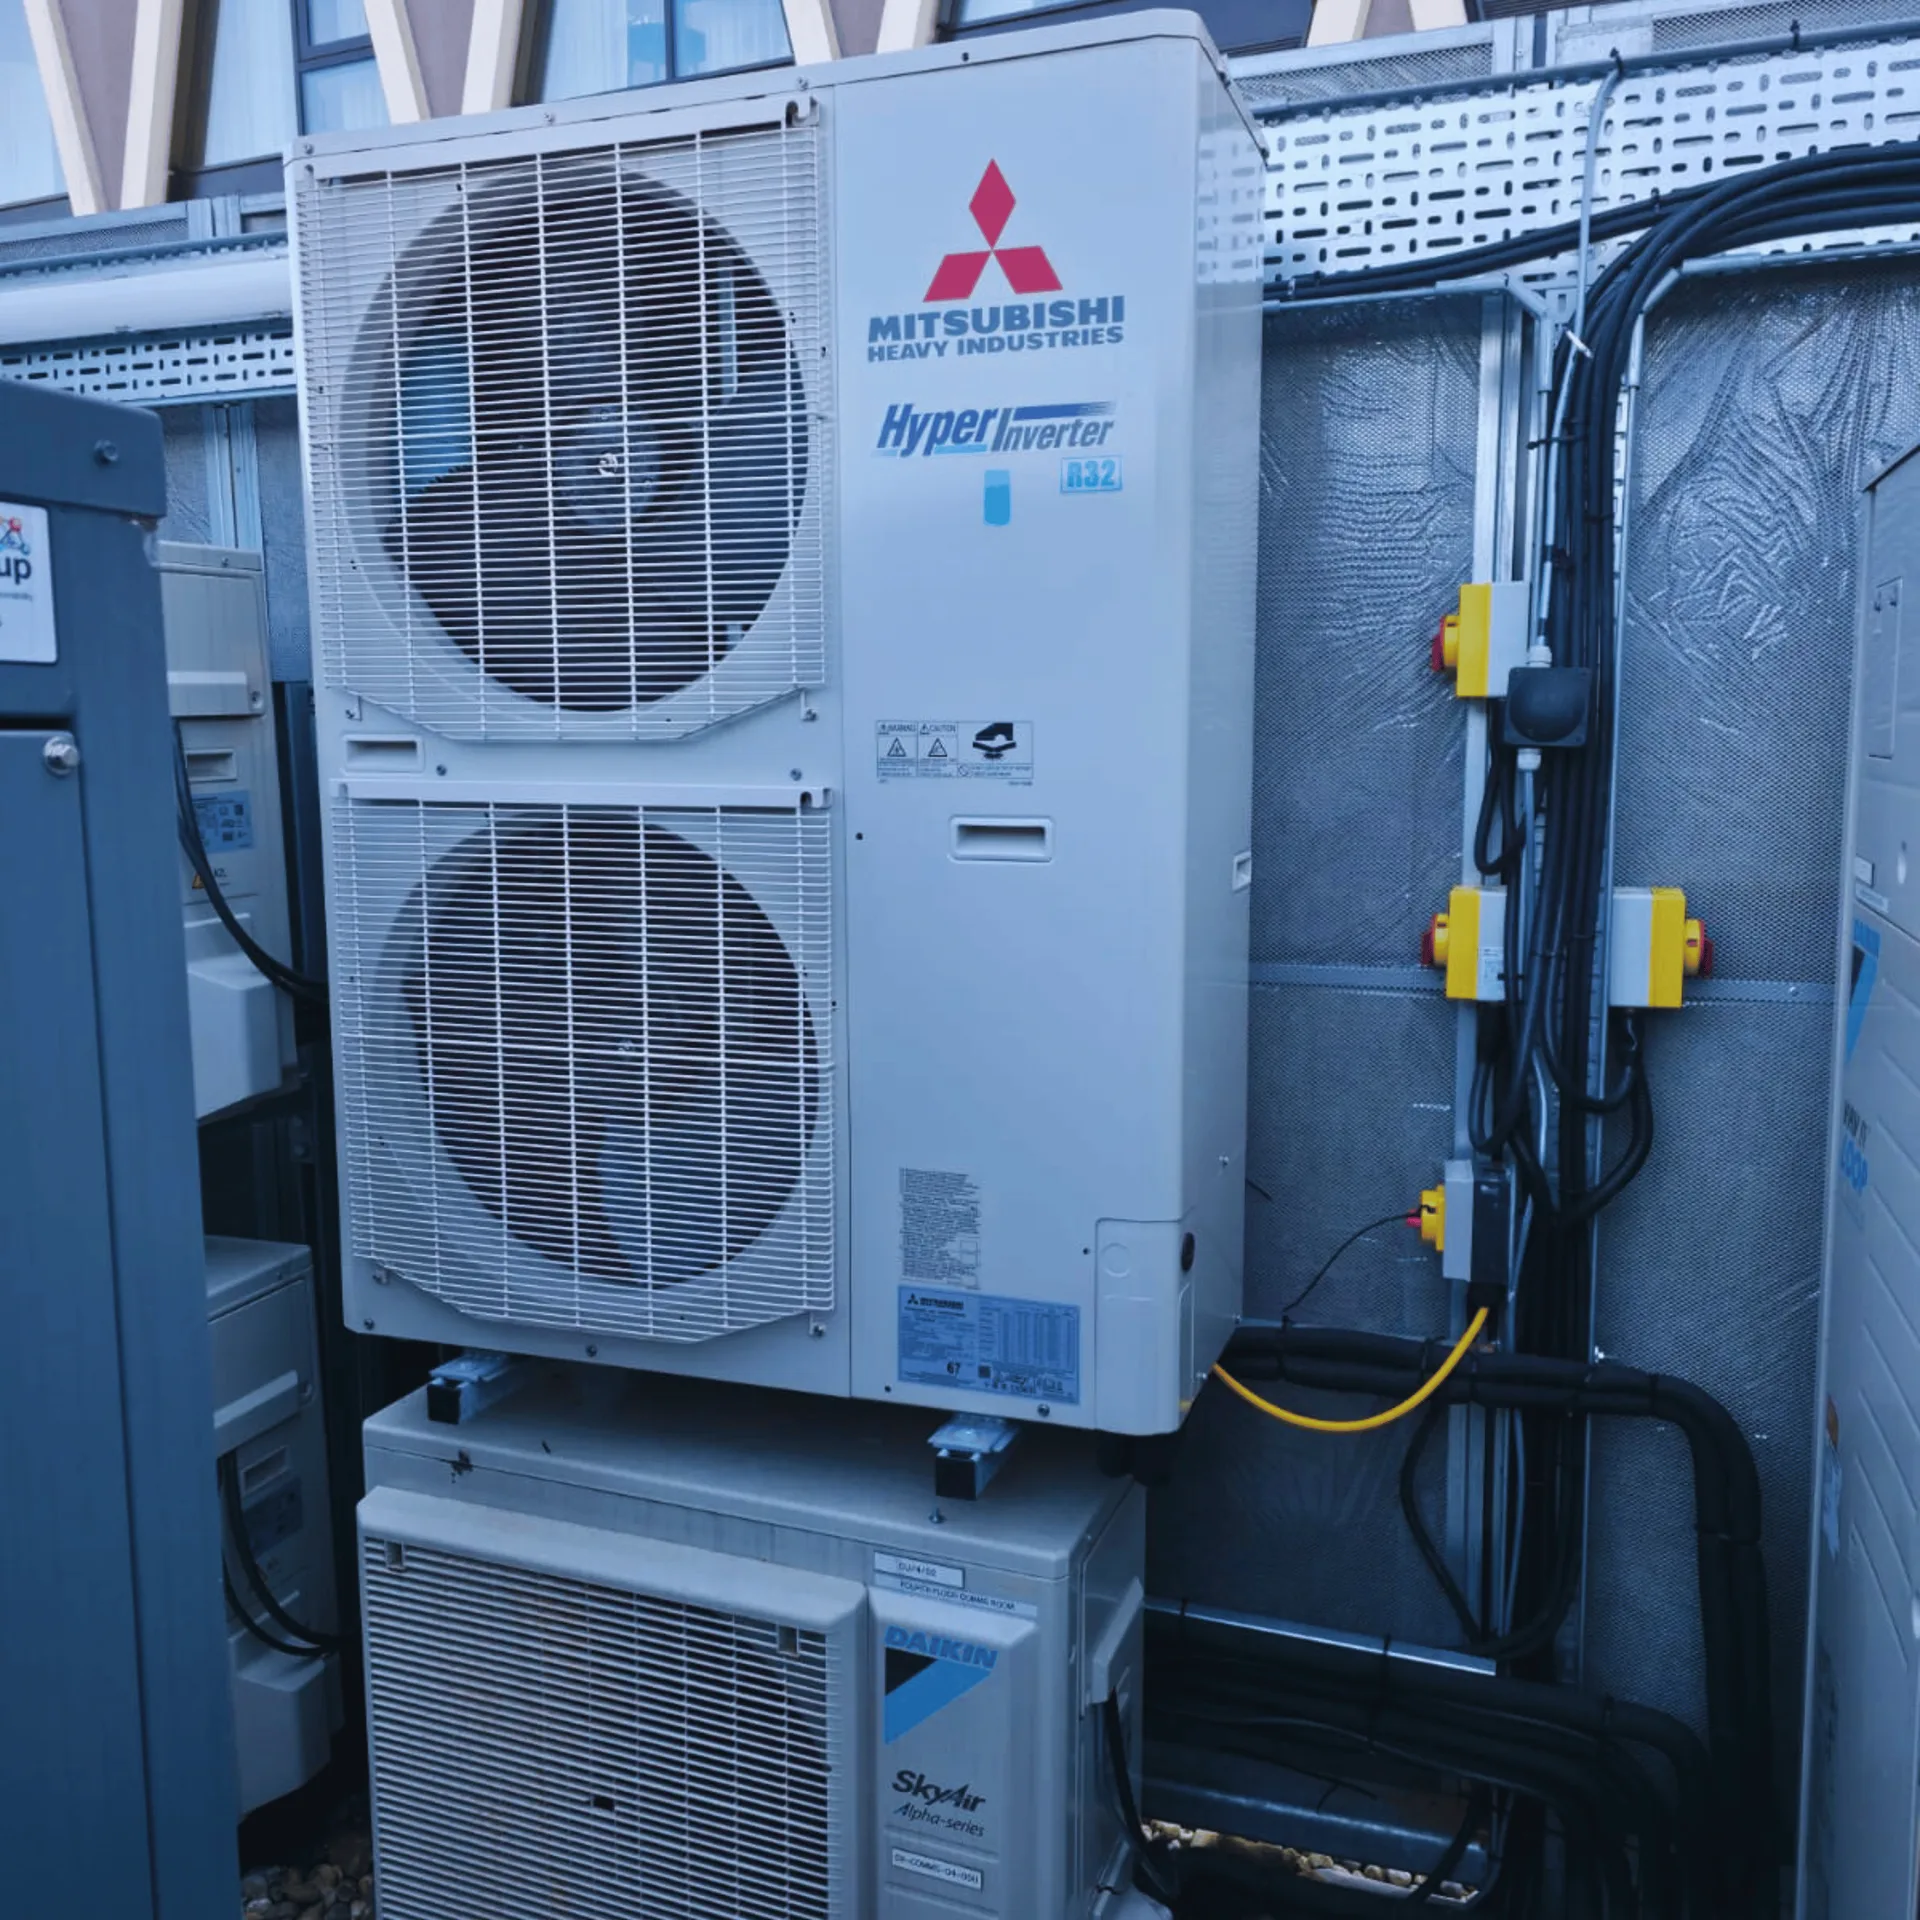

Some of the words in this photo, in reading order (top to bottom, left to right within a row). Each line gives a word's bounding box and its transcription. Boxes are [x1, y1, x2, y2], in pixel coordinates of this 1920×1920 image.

[867, 296, 1125, 343] MITSUBISHI
[867, 340, 949, 363] HEAVY
[957, 326, 1124, 356] INDUSTRIES
[877, 403, 999, 458] Hyper
[991, 407, 1114, 453] Inverter
[1067, 460, 1116, 488] R32
[947, 1361, 960, 1377] 67
[885, 1626, 998, 1669] DAIKIN
[892, 1770, 986, 1812] SkyAir
[893, 1802, 985, 1837] Alpha-series
